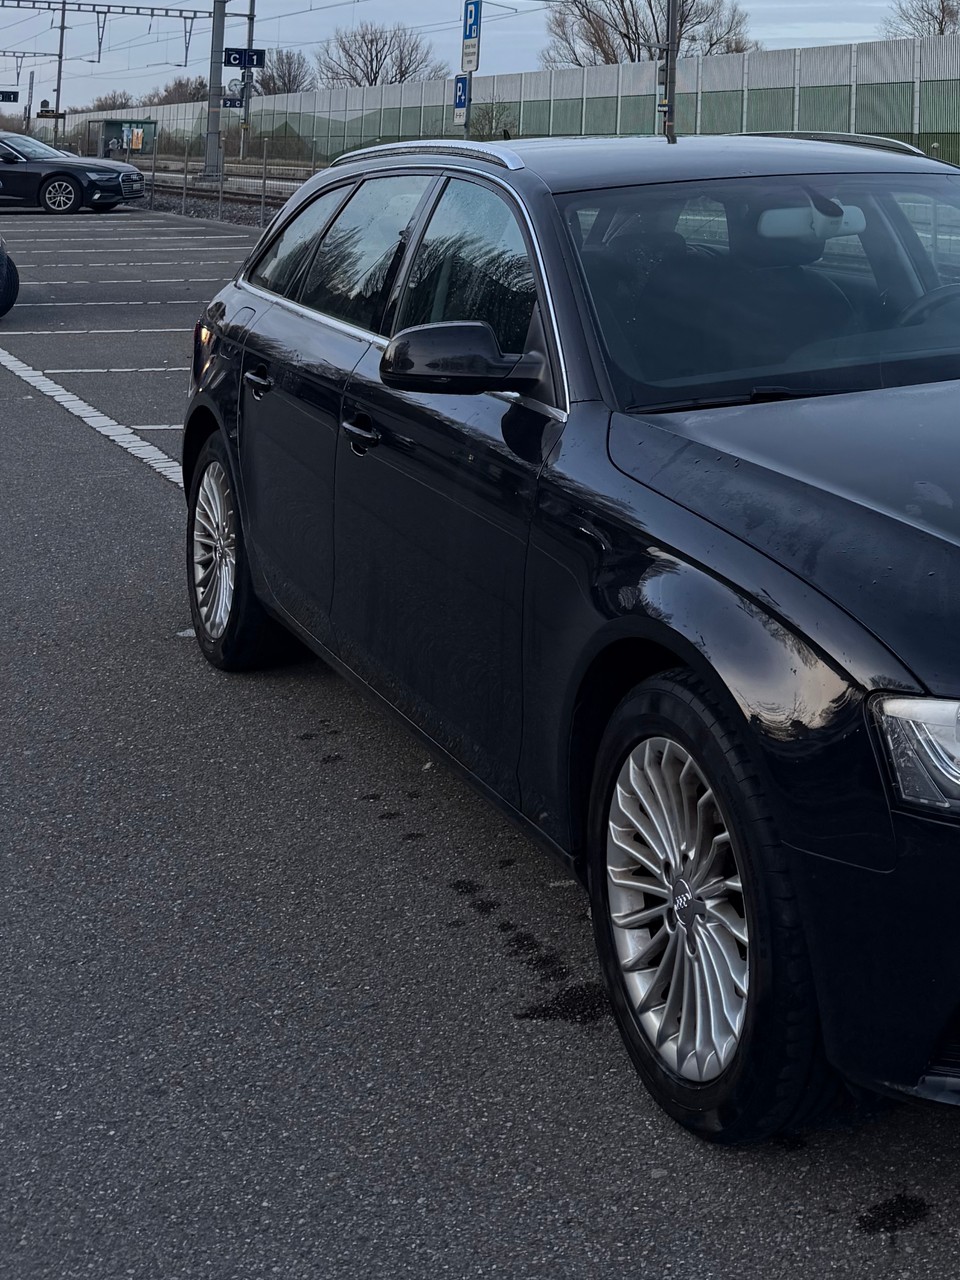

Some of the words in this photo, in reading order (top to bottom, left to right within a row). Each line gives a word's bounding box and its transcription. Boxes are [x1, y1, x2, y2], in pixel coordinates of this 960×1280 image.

[466, 4, 475, 36] P
[230, 54, 239, 64] C
[252, 55, 257, 65] 1
